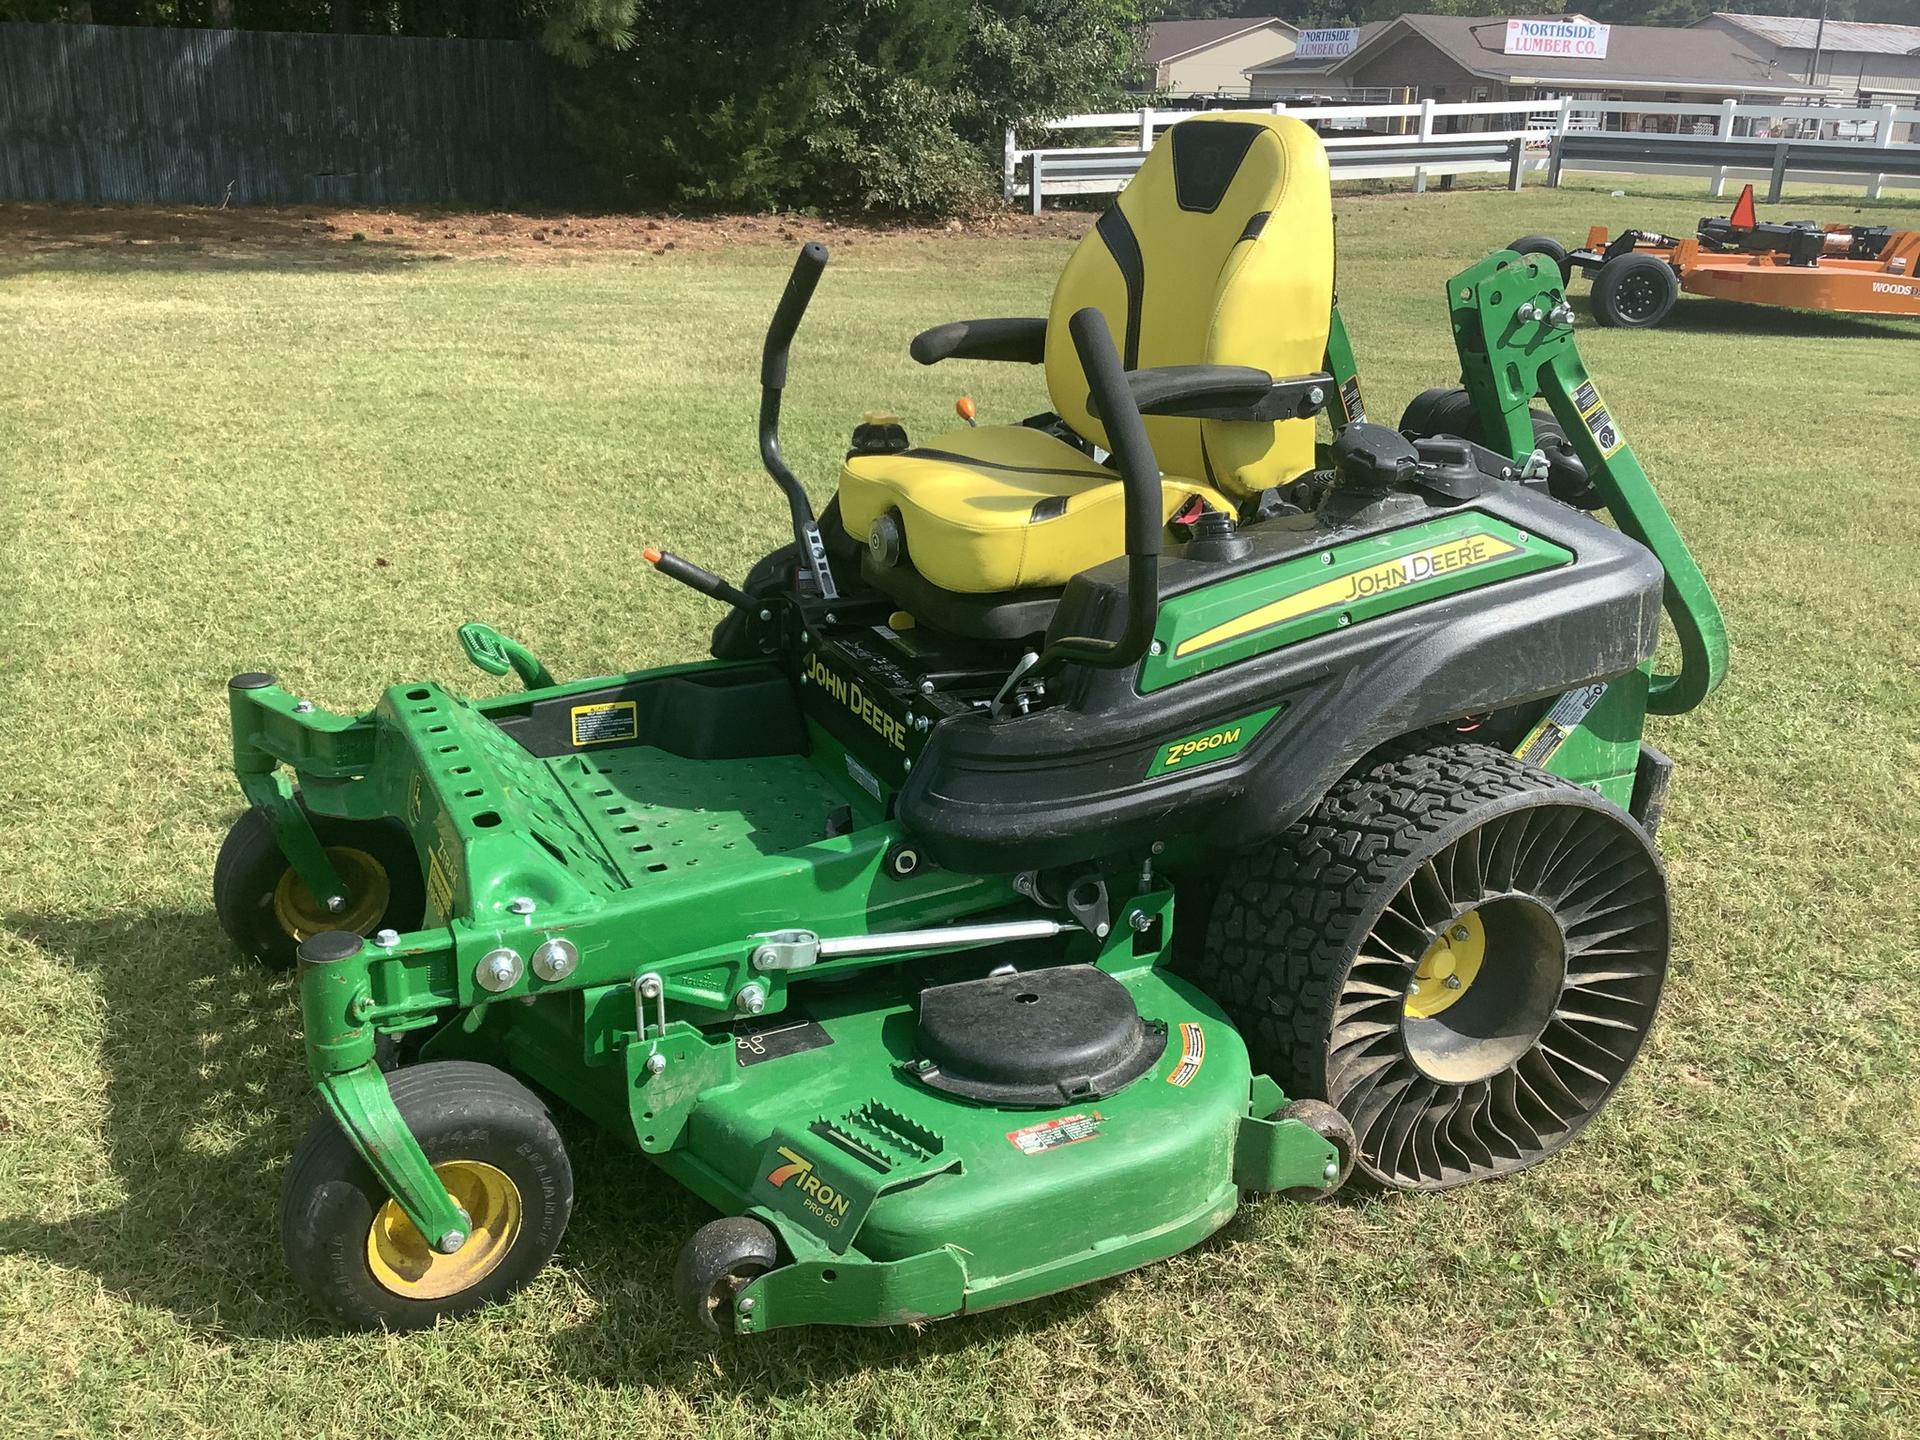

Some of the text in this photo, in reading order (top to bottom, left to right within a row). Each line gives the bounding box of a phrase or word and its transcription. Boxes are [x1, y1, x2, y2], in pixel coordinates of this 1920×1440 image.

[1304, 30, 1351, 42] NORTHSIDE
[1520, 23, 1596, 39] NORTHSIDE
[1300, 43, 1350, 56] LUMBER CO.
[1515, 37, 1597, 54] LUMBER CO.
[1872, 281, 1912, 296] WOODS
[1344, 542, 1487, 600] JOHN DEERE
[807, 652, 847, 705] JOHN
[850, 682, 906, 752] DEERE
[1164, 727, 1242, 767] Z960M
[802, 1198, 840, 1229] PRO 60
